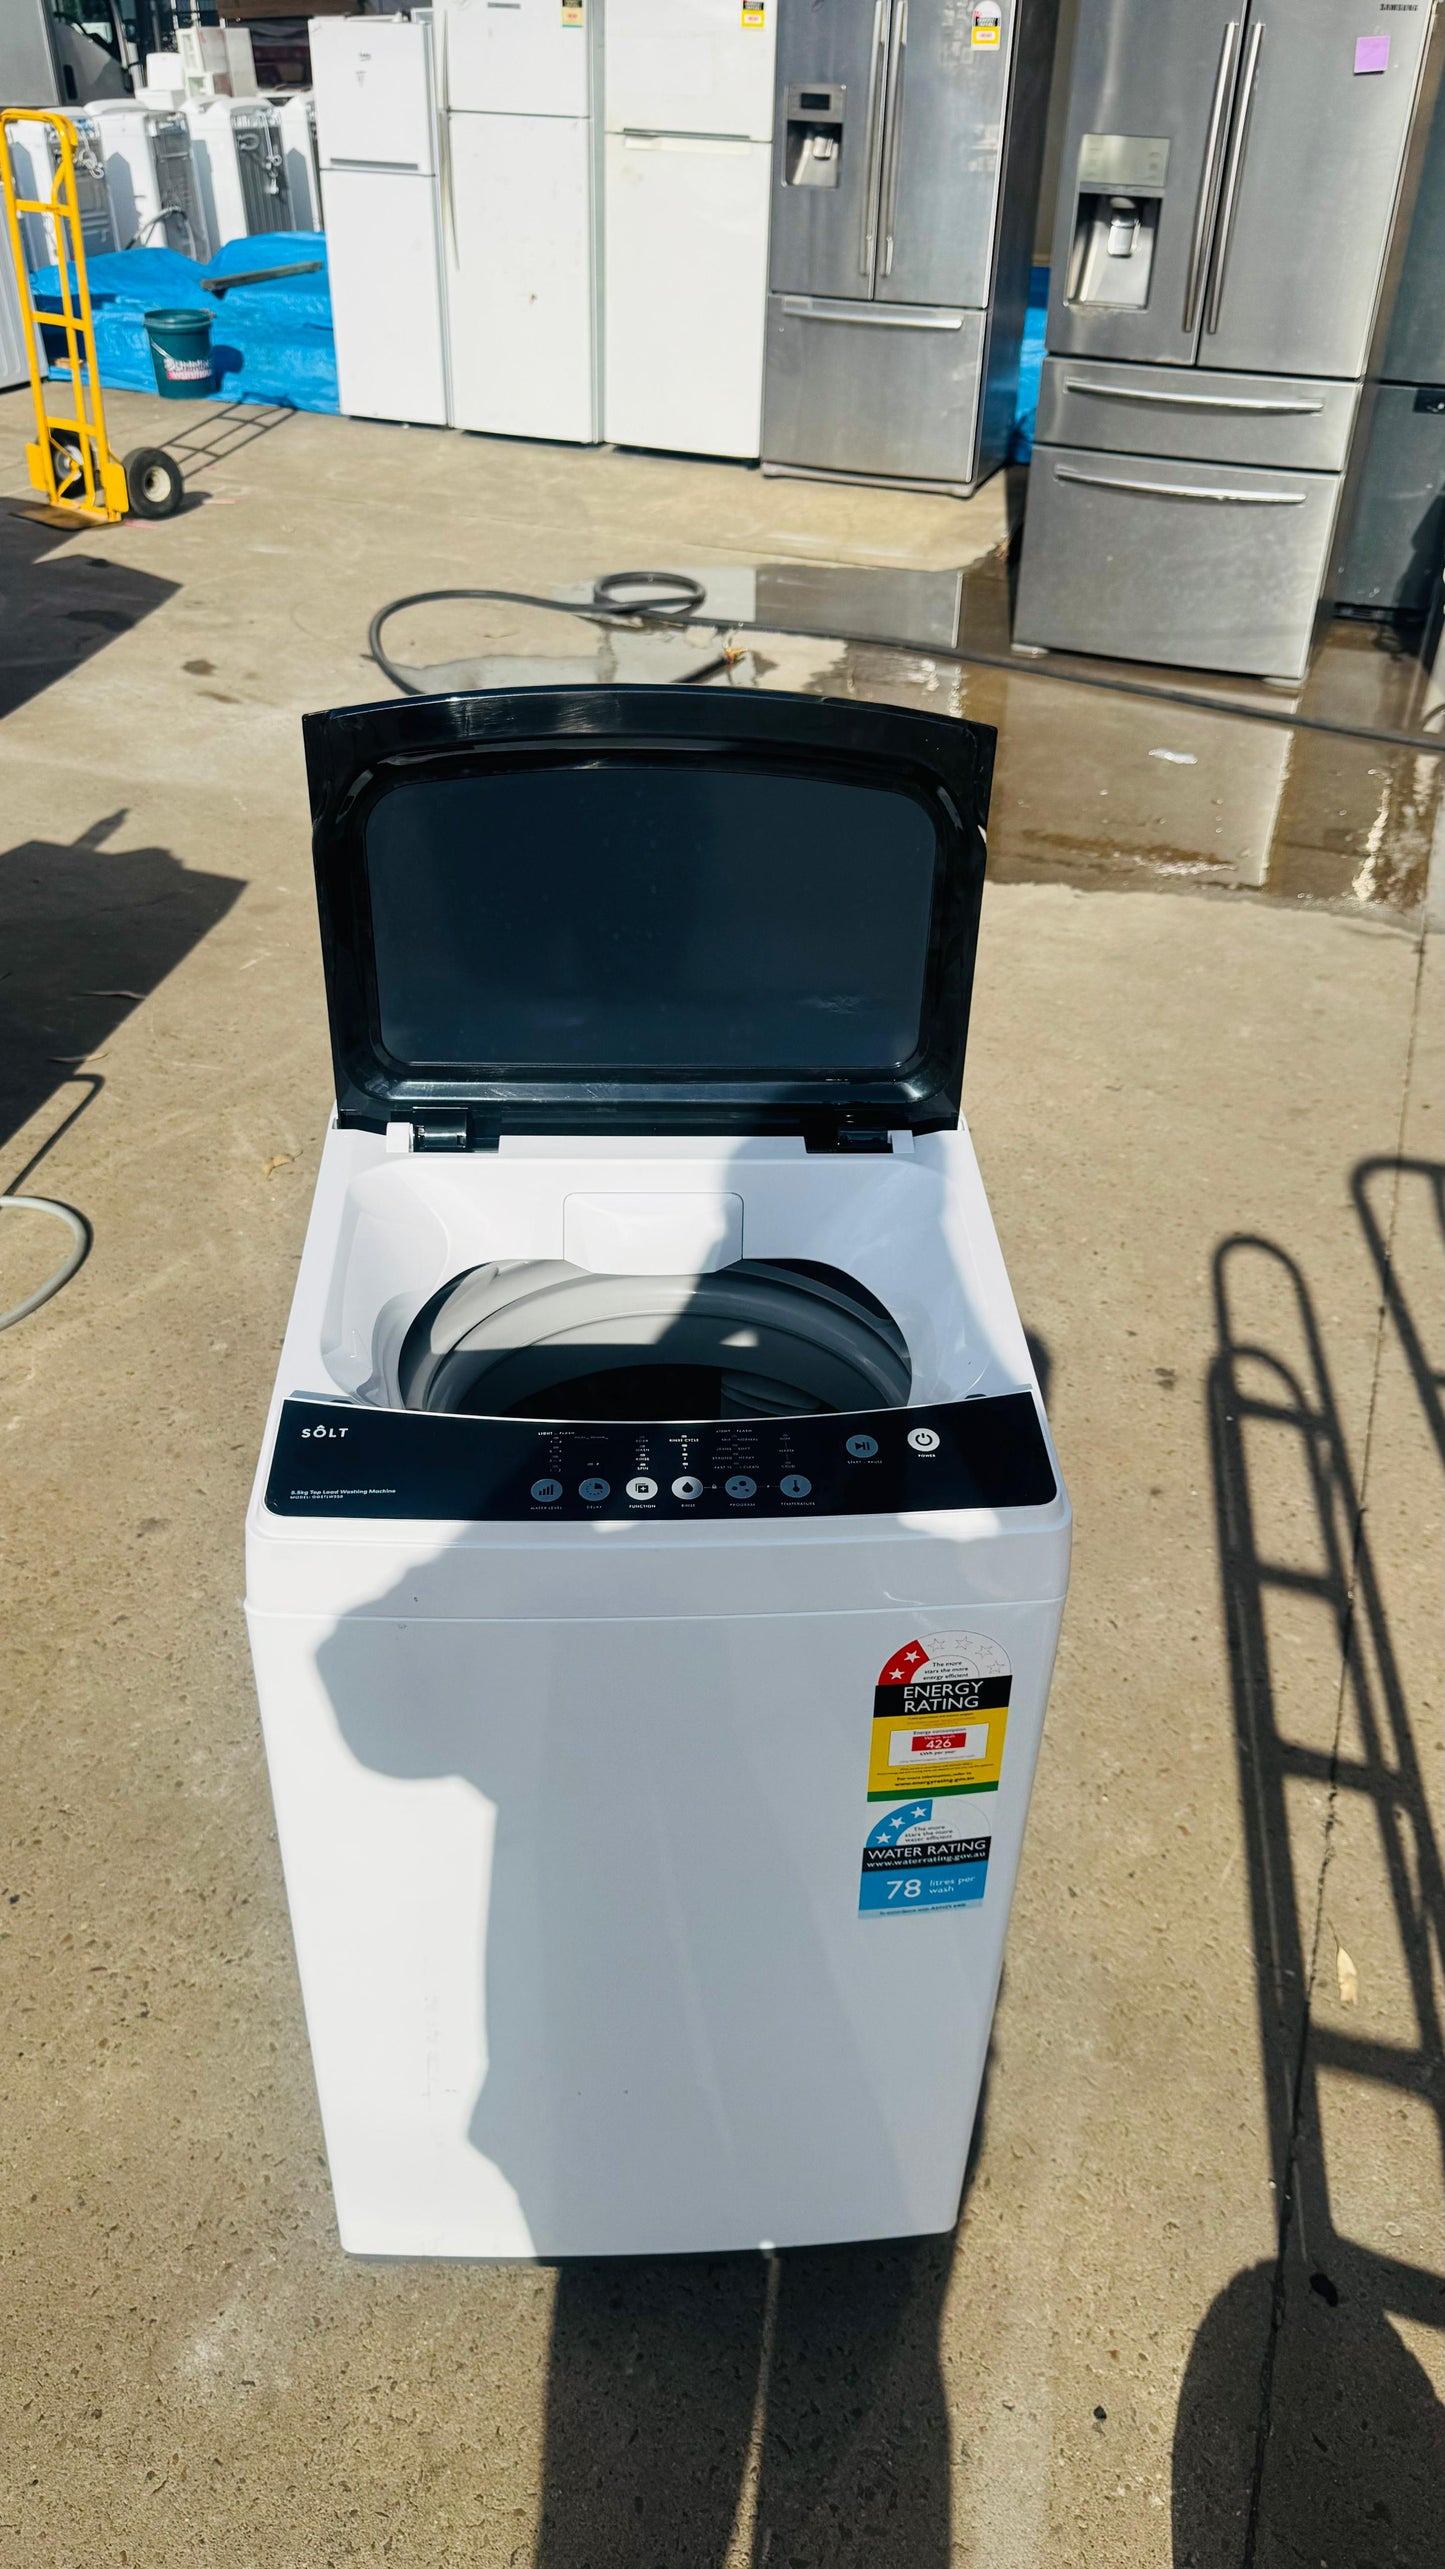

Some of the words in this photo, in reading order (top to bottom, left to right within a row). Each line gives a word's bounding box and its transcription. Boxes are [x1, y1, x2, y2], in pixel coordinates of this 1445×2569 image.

[301, 1424, 349, 1438] SÔLT
[903, 1680, 984, 1699] ENERGY
[904, 1695, 979, 1713] RATING
[926, 1739, 952, 1749] 426
[868, 1847, 923, 1860] WATER
[927, 1840, 986, 1856] RATING
[866, 1851, 986, 1868] www.waterrating.gov.au
[886, 1879, 922, 1900] 78
[929, 1878, 955, 1887] litres
[957, 1876, 976, 1886] per
[928, 1886, 955, 1895] wash
